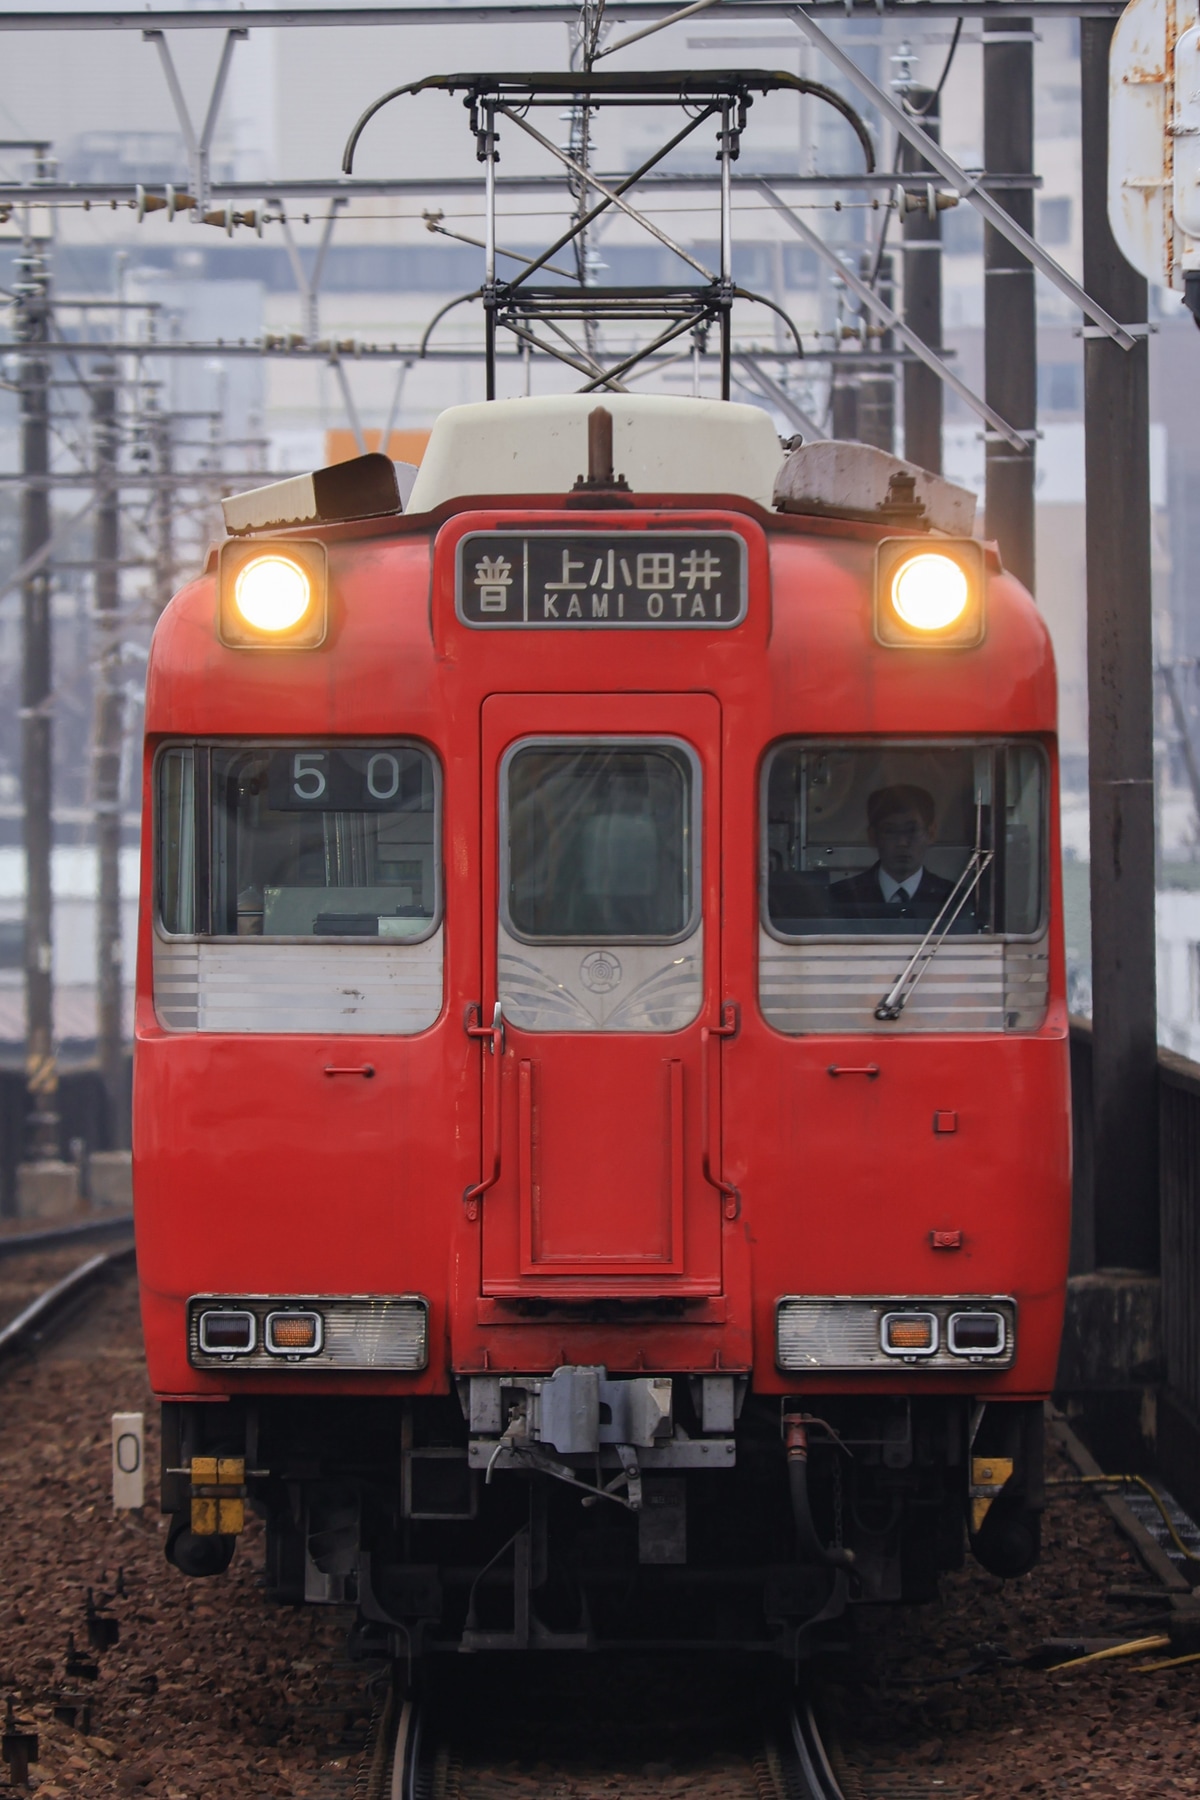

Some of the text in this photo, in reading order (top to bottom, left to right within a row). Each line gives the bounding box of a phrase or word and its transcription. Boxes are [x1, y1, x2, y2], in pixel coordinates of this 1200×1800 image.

[474, 555, 513, 612] 普
[544, 549, 722, 590] 上小田井
[544, 593, 721, 618] KAMI OTAI
